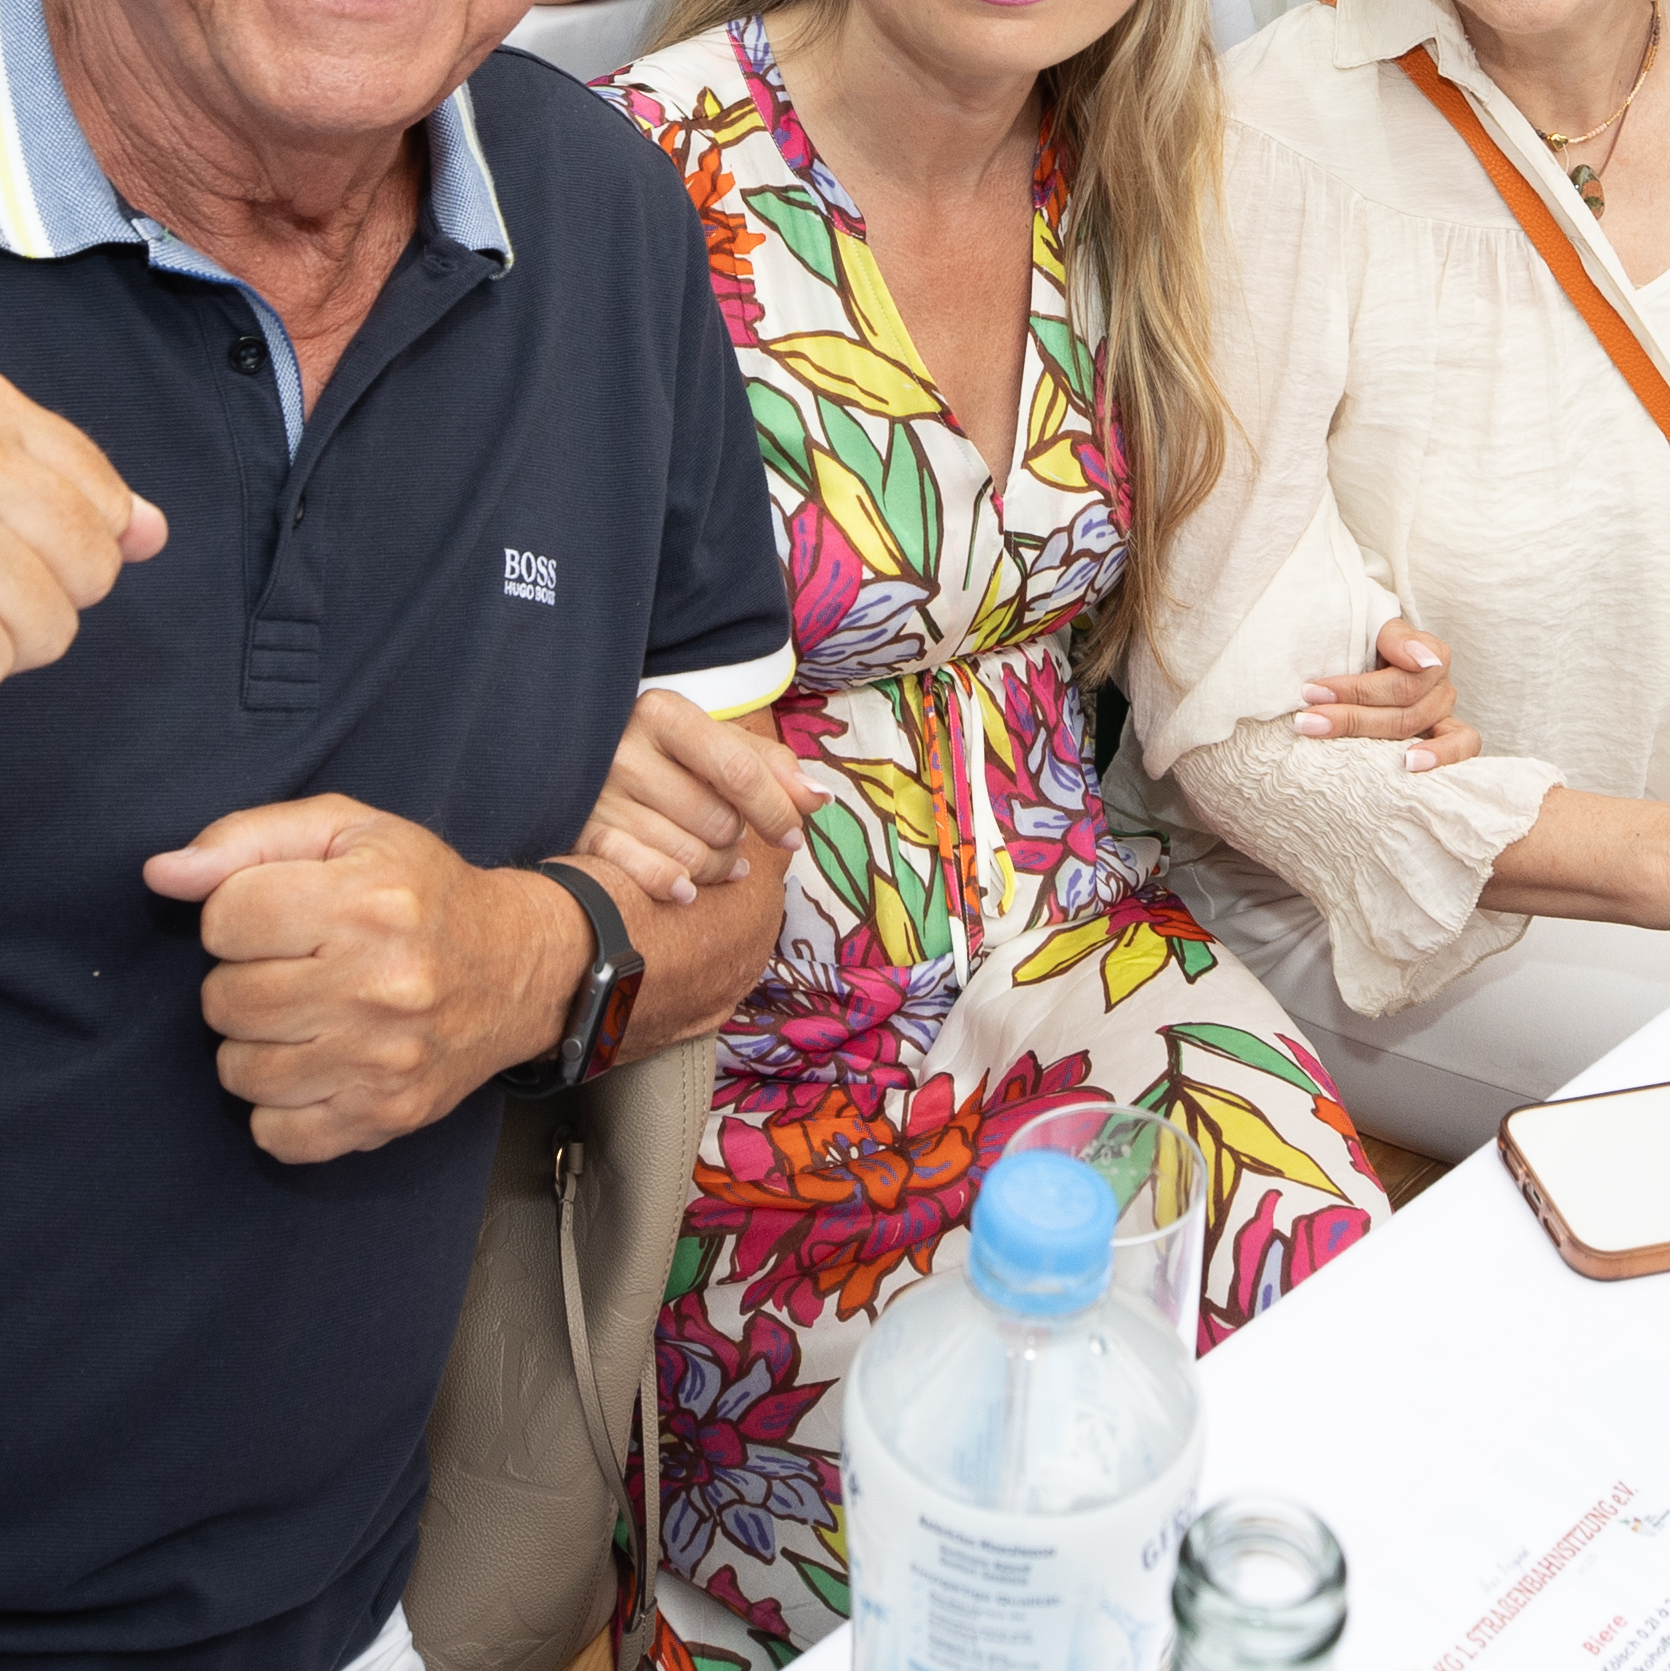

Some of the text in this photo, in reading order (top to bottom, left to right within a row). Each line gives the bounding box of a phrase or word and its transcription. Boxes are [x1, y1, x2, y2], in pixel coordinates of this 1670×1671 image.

[503, 548, 558, 590] BOSS
[503, 580, 535, 601] HUGO
[1454, 1644, 1478, 1661] 1.
[1466, 1500, 1618, 1648] STRAßENBAHNSITZUNG
[1611, 1480, 1635, 1506] e.V.
[1581, 1615, 1628, 1656] Biere
